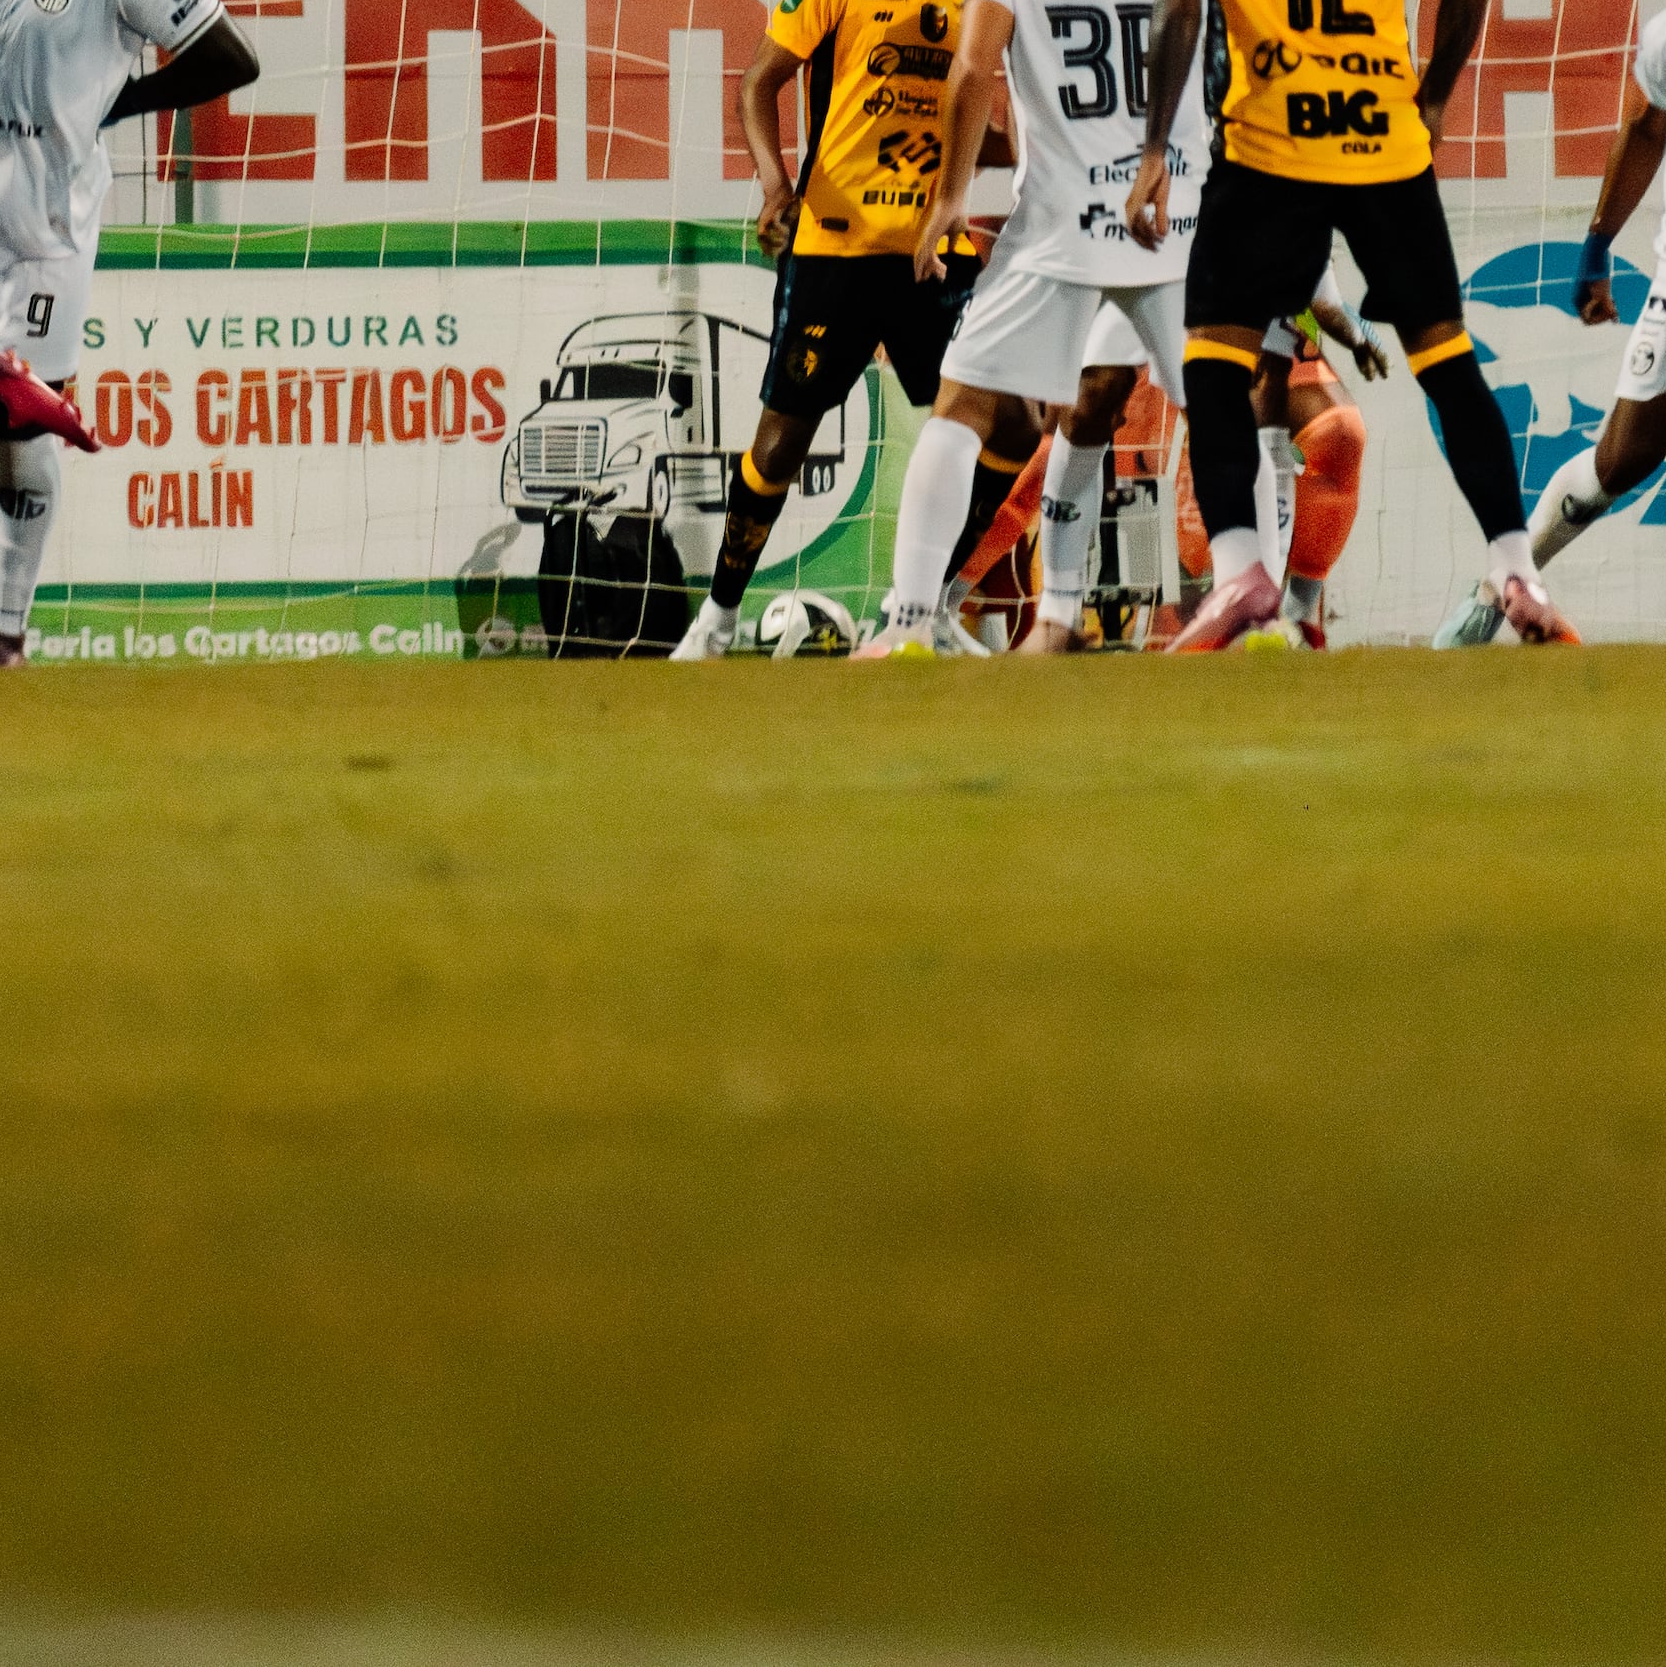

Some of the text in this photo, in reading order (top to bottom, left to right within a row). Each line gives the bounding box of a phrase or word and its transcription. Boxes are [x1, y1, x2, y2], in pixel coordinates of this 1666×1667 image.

[1286, 90, 1390, 139] BIG
[26, 292, 55, 338] 9
[133, 317, 159, 349] Y
[186, 313, 460, 349] VERDURAS
[195, 364, 507, 447] CARTAGOS
[127, 454, 254, 529] CALÍN
[124, 626, 176, 659] los
[185, 625, 362, 660] Cartagos
